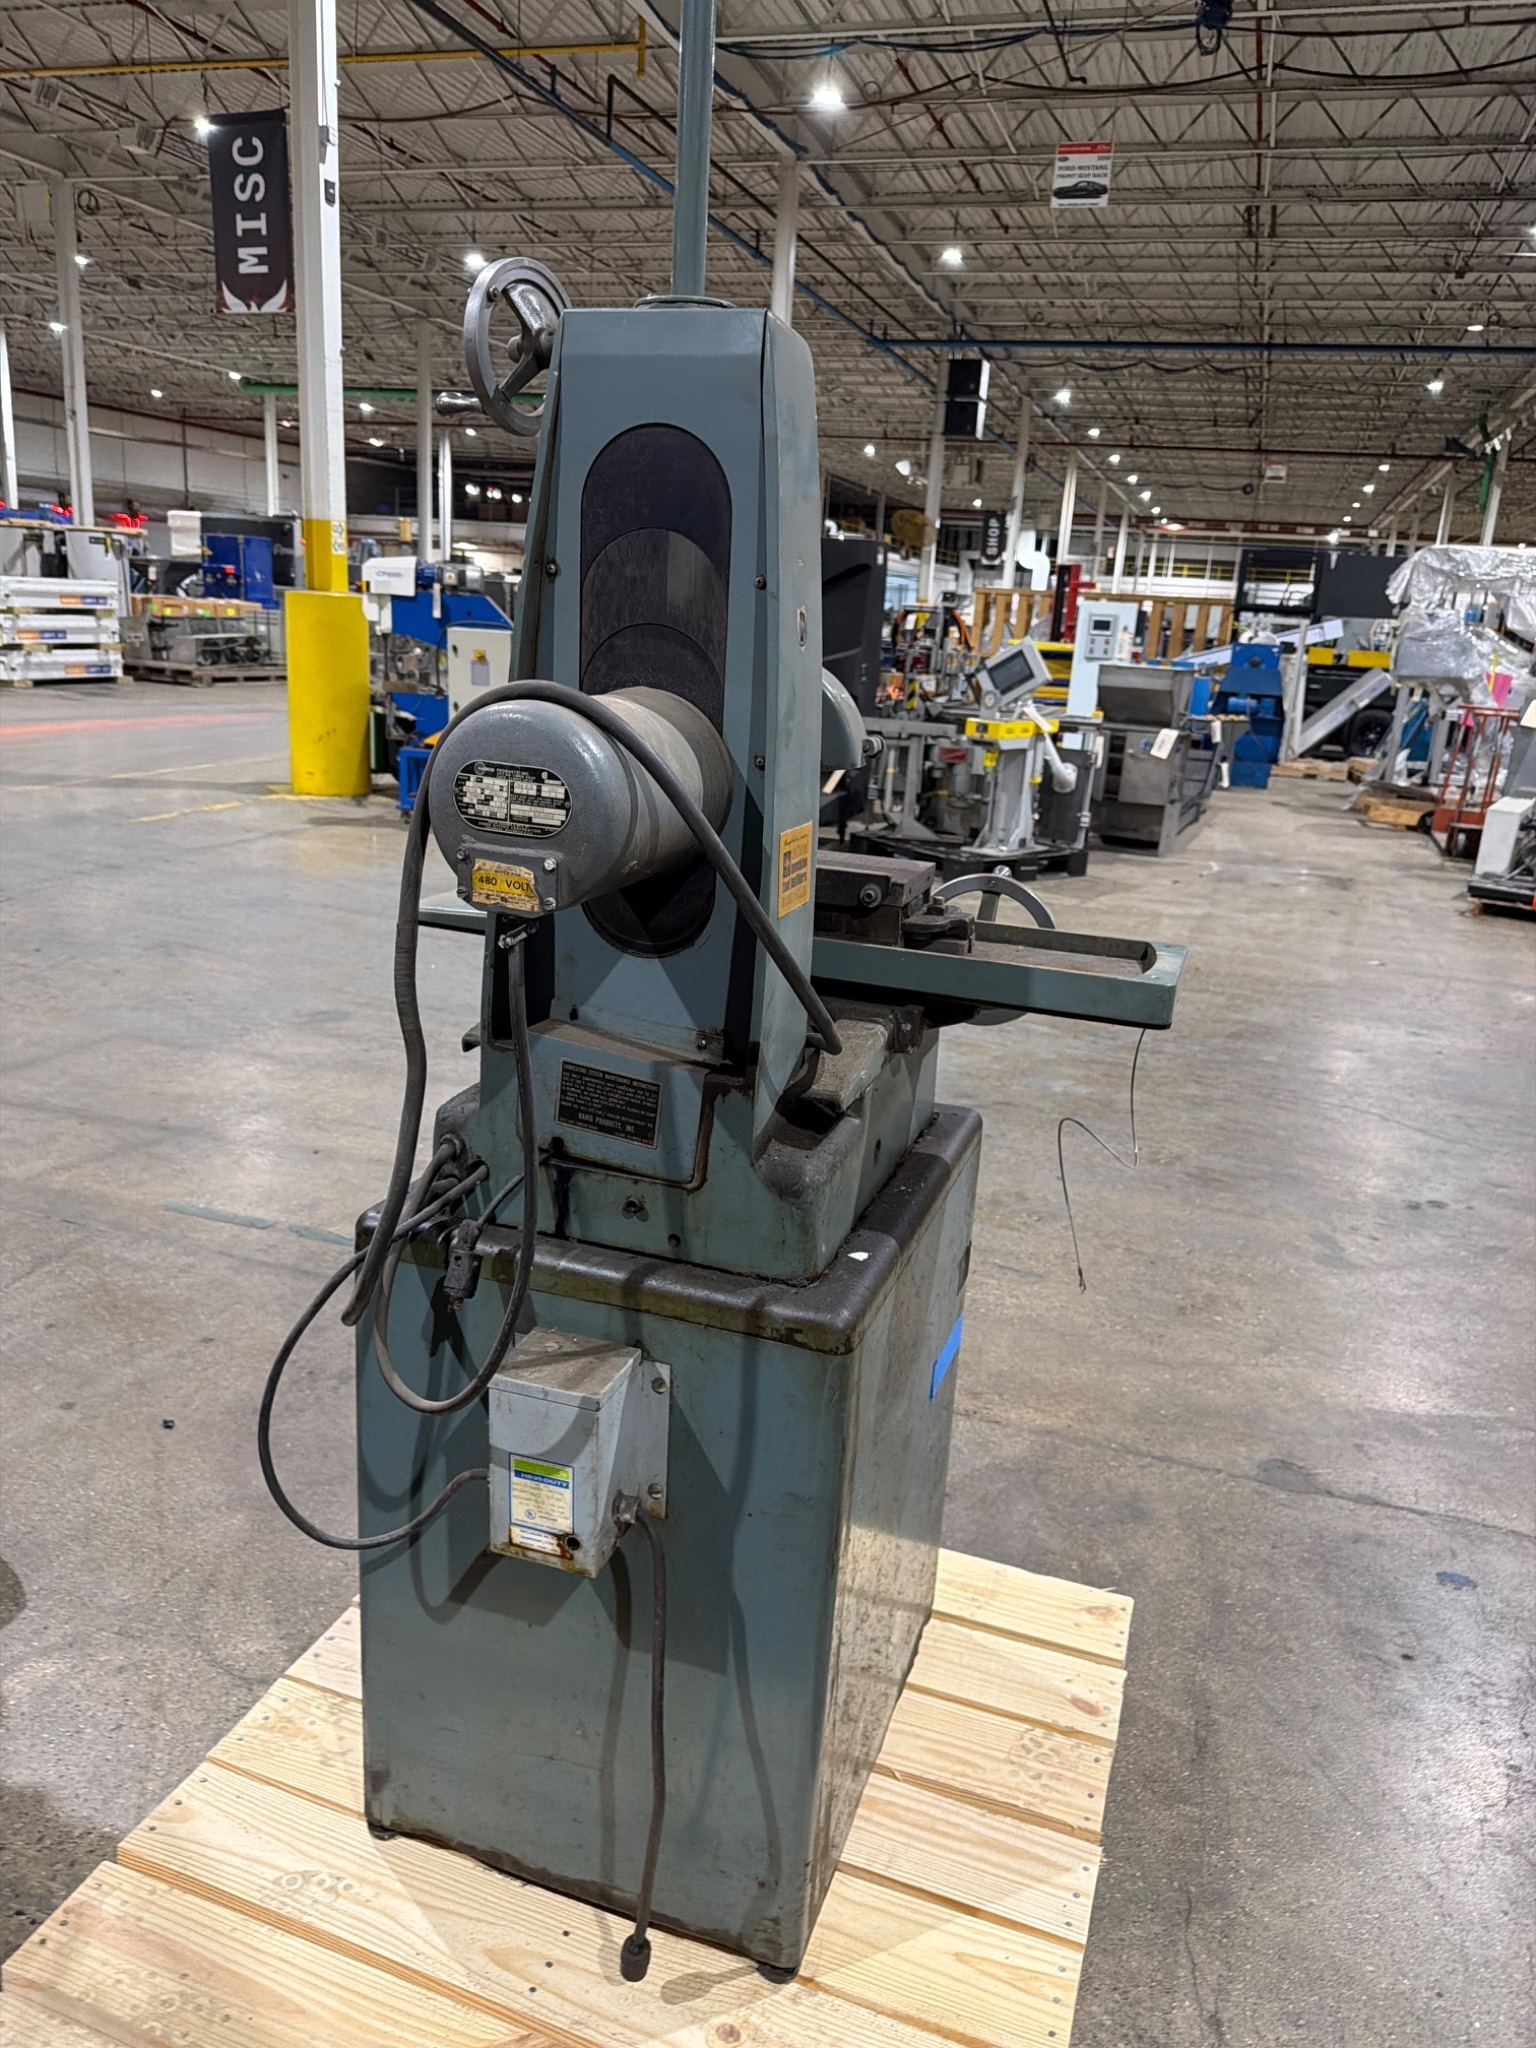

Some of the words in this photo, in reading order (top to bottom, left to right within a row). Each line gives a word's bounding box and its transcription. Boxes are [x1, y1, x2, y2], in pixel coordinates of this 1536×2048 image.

[231, 136, 269, 274] MISC
[985, 517, 1000, 556] SHOP
[478, 875, 498, 886] 480
[520, 1472, 569, 1488] HEVI-DUTY
